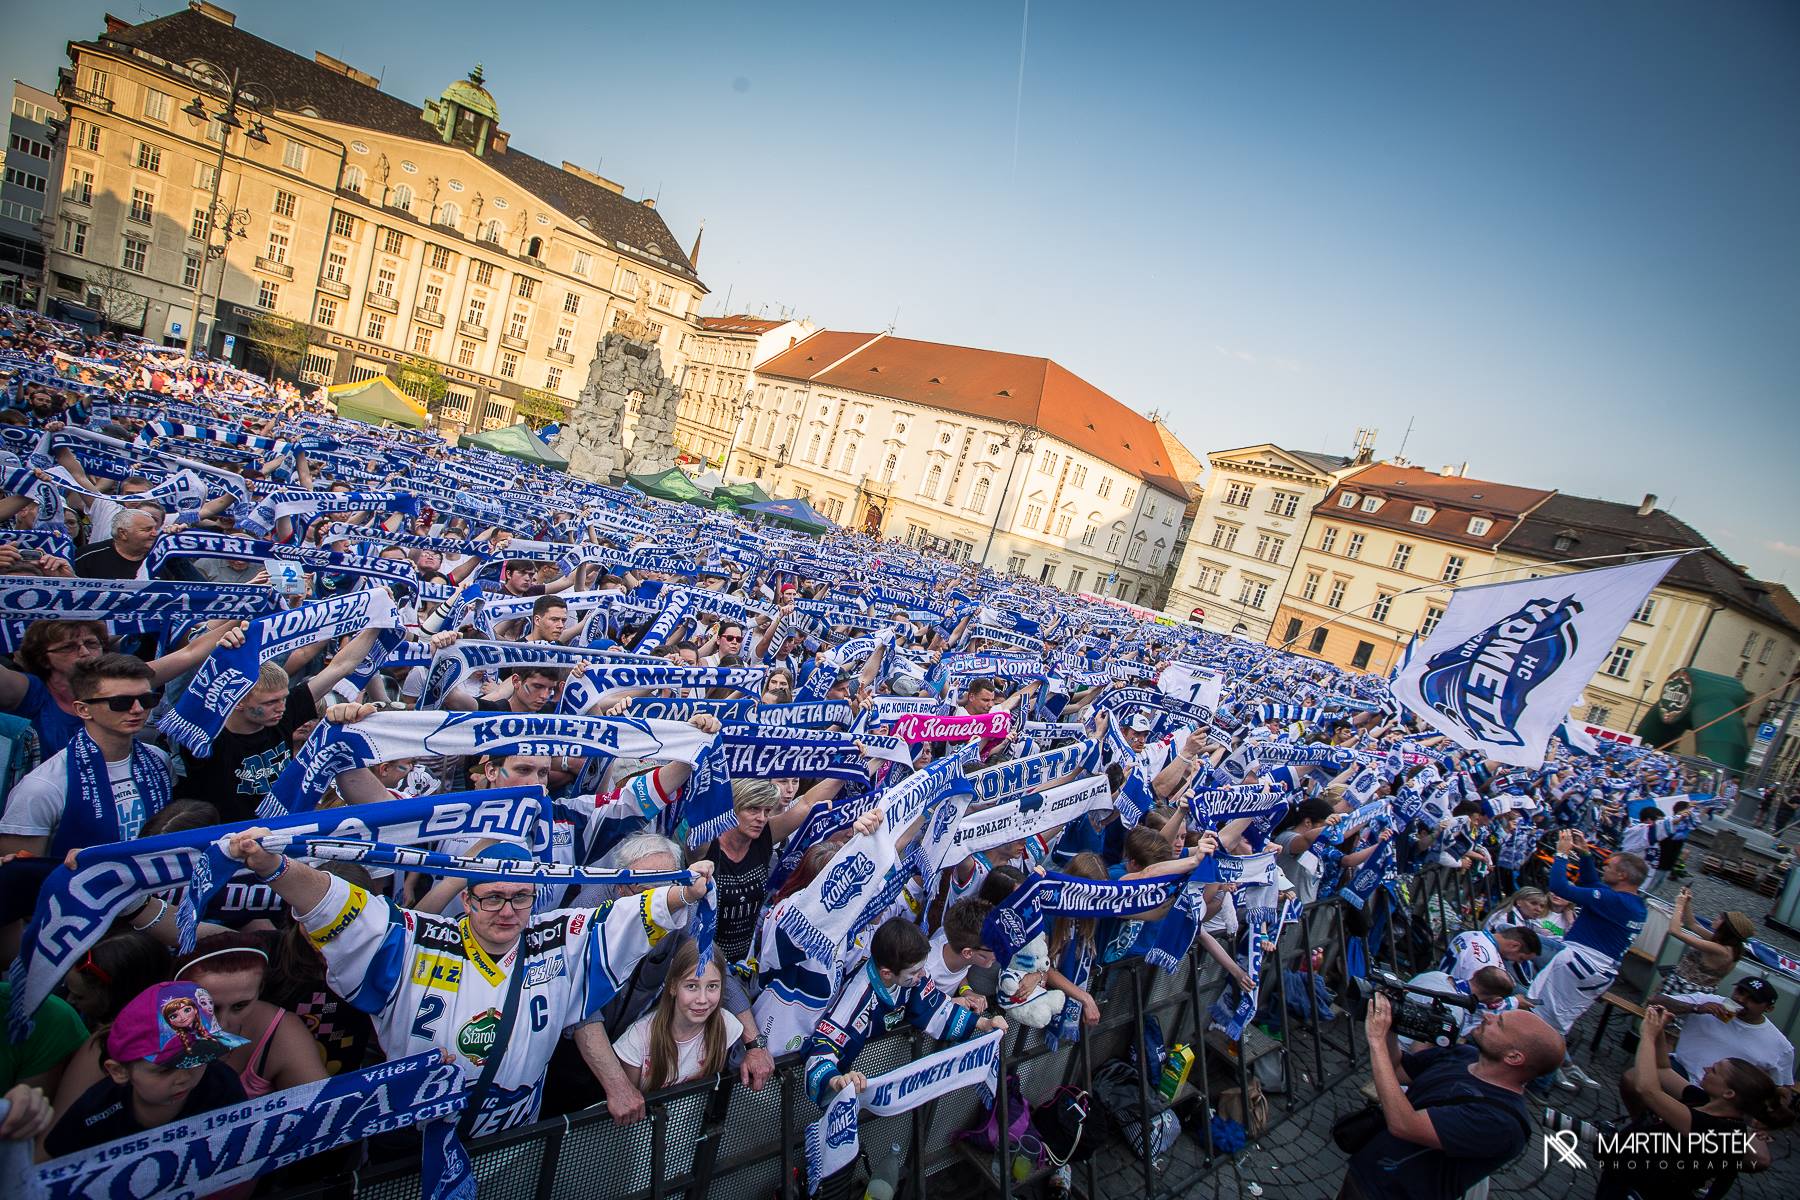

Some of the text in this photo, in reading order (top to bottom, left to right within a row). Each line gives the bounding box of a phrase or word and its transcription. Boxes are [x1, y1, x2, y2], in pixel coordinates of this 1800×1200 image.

[446, 367, 497, 389] HOTEL
[443, 462, 506, 487] KOMETA
[407, 481, 457, 500] KOMETA
[659, 555, 698, 575] BRNO
[260, 590, 370, 647] KOMETA
[334, 617, 370, 639] BRNO
[261, 633, 317, 661] SINCE 1953
[986, 628, 1027, 648] KOMETA
[586, 666, 718, 694] KOMETA
[1466, 600, 1559, 745] KOMETA
[1516, 654, 1540, 682] HC
[204, 667, 243, 715] KOMETA
[1189, 682, 1203, 703] 1
[760, 704, 823, 730] KOMETA
[879, 704, 891, 716] HC
[892, 703, 920, 717] KOMETA
[473, 717, 619, 751] KOMETA
[755, 725, 842, 743] KOMETA
[850, 733, 899, 750] BRNO
[920, 717, 987, 740] Kometa
[1762, 725, 1774, 736] P
[517, 743, 583, 757] BRNO
[822, 853, 872, 913] KOMETA
[471, 950, 496, 979] Tipsport
[411, 993, 447, 1042] 2
[529, 994, 549, 1033] C
[361, 1059, 419, 1083] Vítěz
[872, 1082, 893, 1107] HC
[898, 1057, 956, 1100] KOMETA
[93, 1125, 197, 1162] 1955-58,
[204, 1095, 289, 1132] 1960-66
